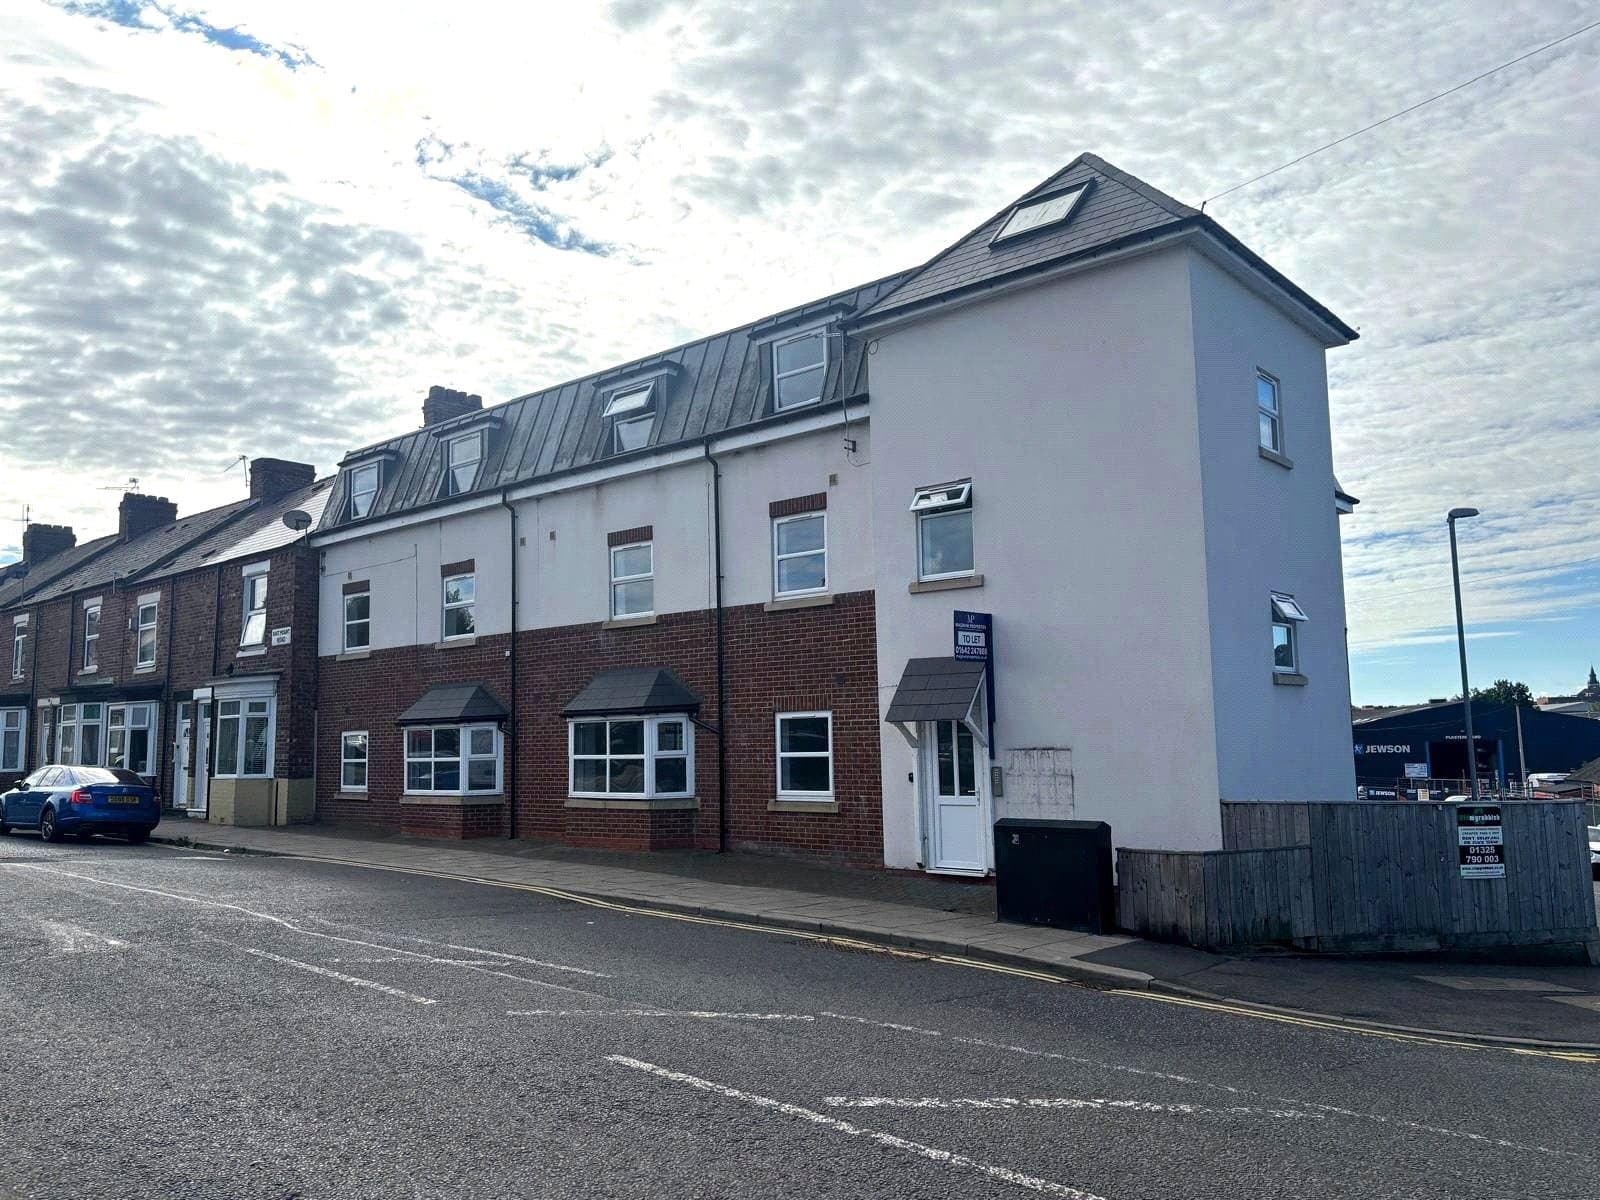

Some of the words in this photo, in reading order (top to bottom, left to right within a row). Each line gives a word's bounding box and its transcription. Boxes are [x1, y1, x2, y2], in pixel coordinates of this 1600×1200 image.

[962, 634, 971, 643] TO
[971, 635, 981, 644] LET
[955, 646, 970, 655] 01642
[1365, 744, 1411, 753] JEWSON
[1469, 846, 1496, 854] 01325
[1465, 855, 1482, 863] 790
[1484, 855, 1499, 863] 003
